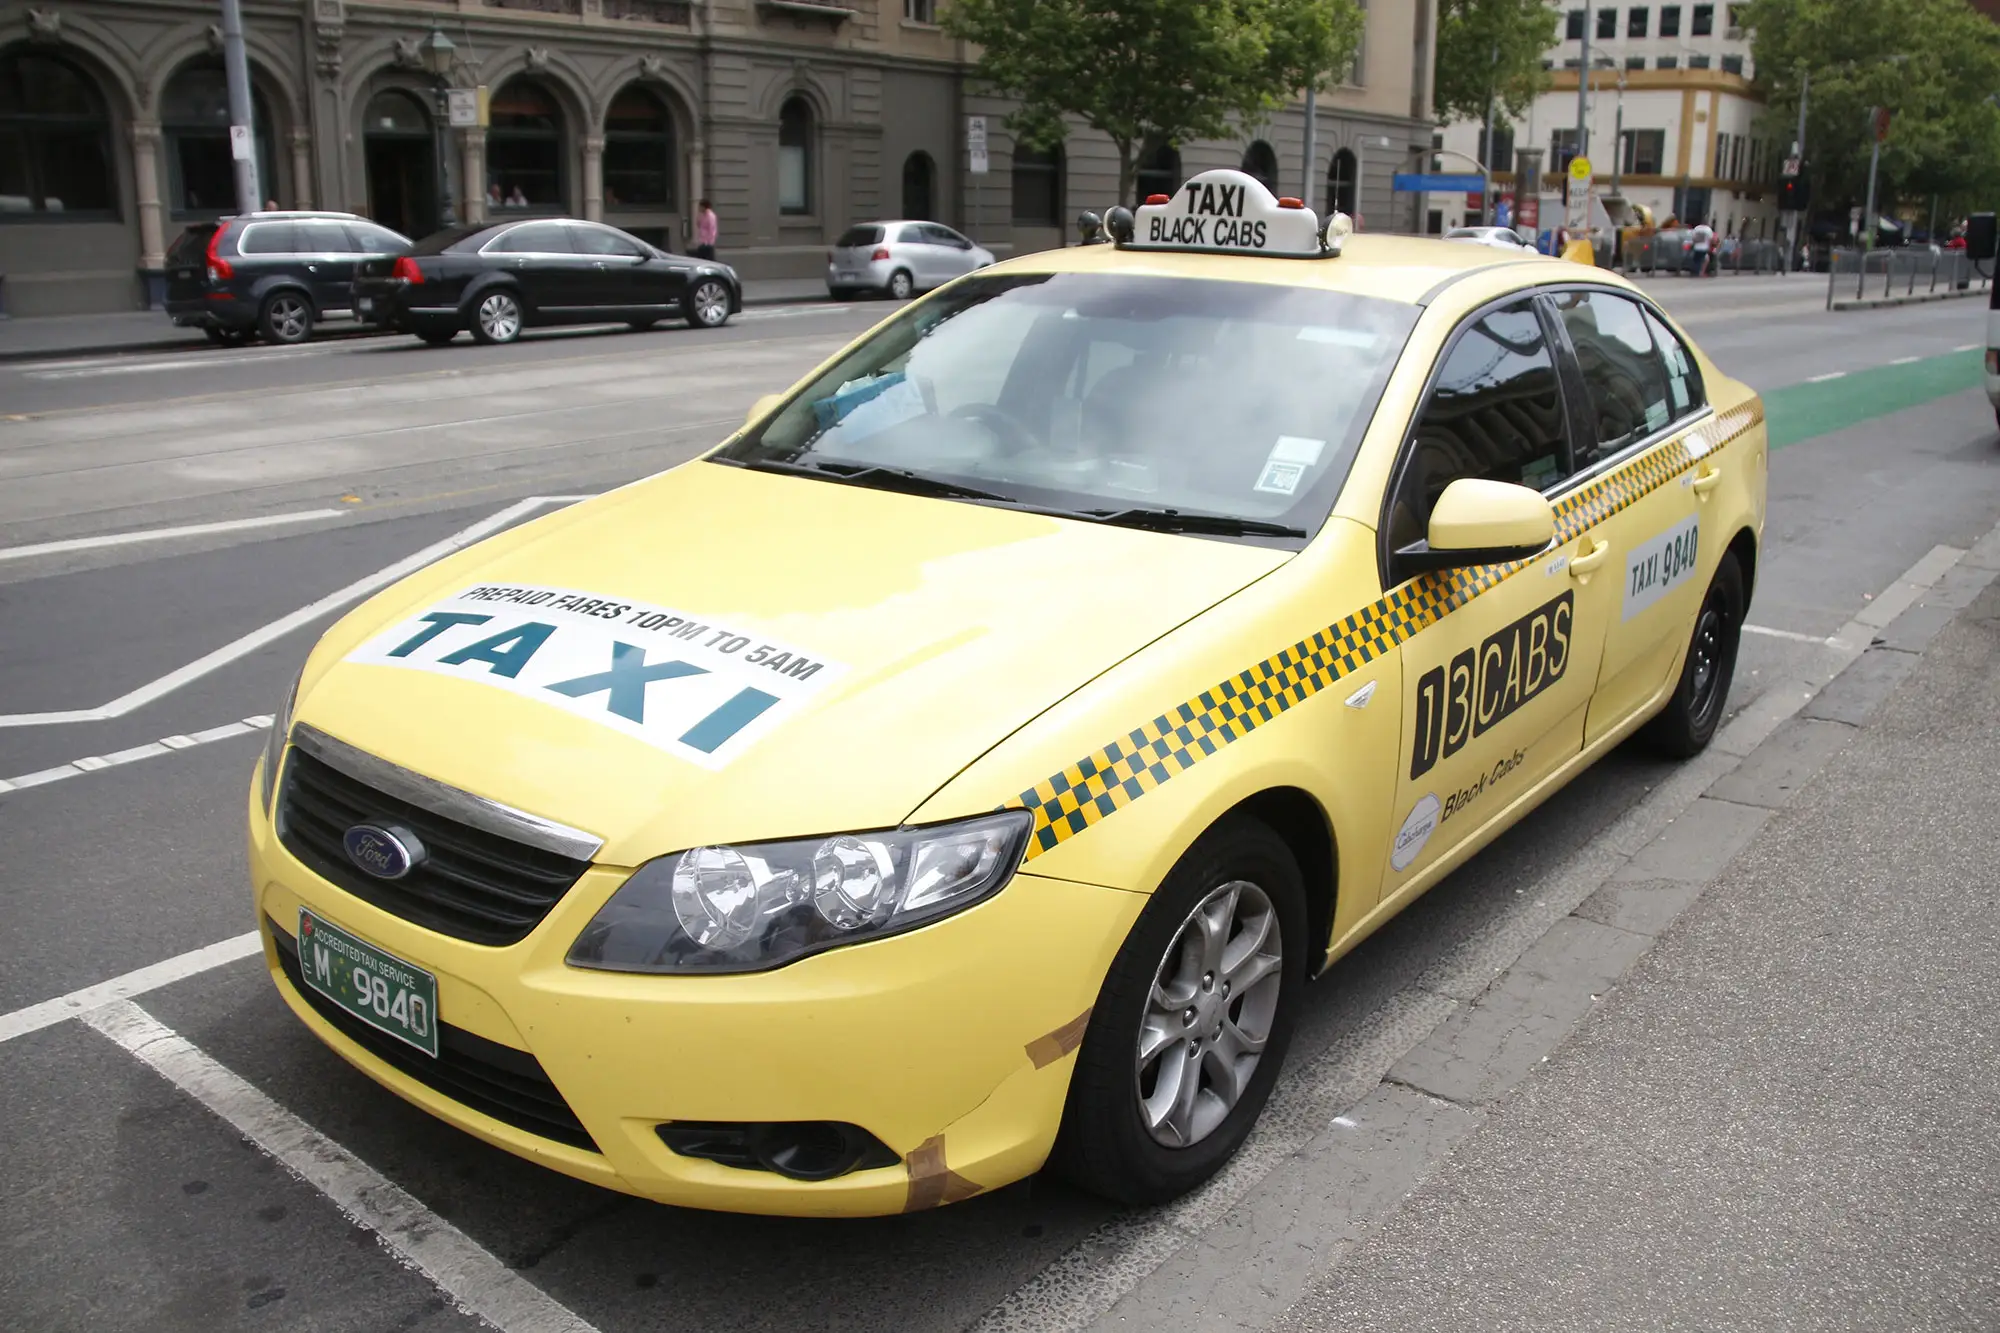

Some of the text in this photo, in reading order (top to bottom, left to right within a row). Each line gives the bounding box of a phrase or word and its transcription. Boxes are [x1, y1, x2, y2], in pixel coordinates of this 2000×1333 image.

[1150, 216, 1267, 248] BLACK CABS
[1186, 182, 1245, 217] TAXI
[1631, 525, 1698, 597] TAXI 9840
[459, 586, 824, 681] PREPAID FARES 10PM TO 5AM
[386, 611, 782, 754] TAXI
[1423, 600, 1571, 761] 13CABS
[1441, 748, 1526, 823] Black Cabs
[354, 834, 393, 870] Ford
[313, 943, 428, 1037] M 9840
[314, 928, 416, 990] ACCREDITED TAXI SERVICE
